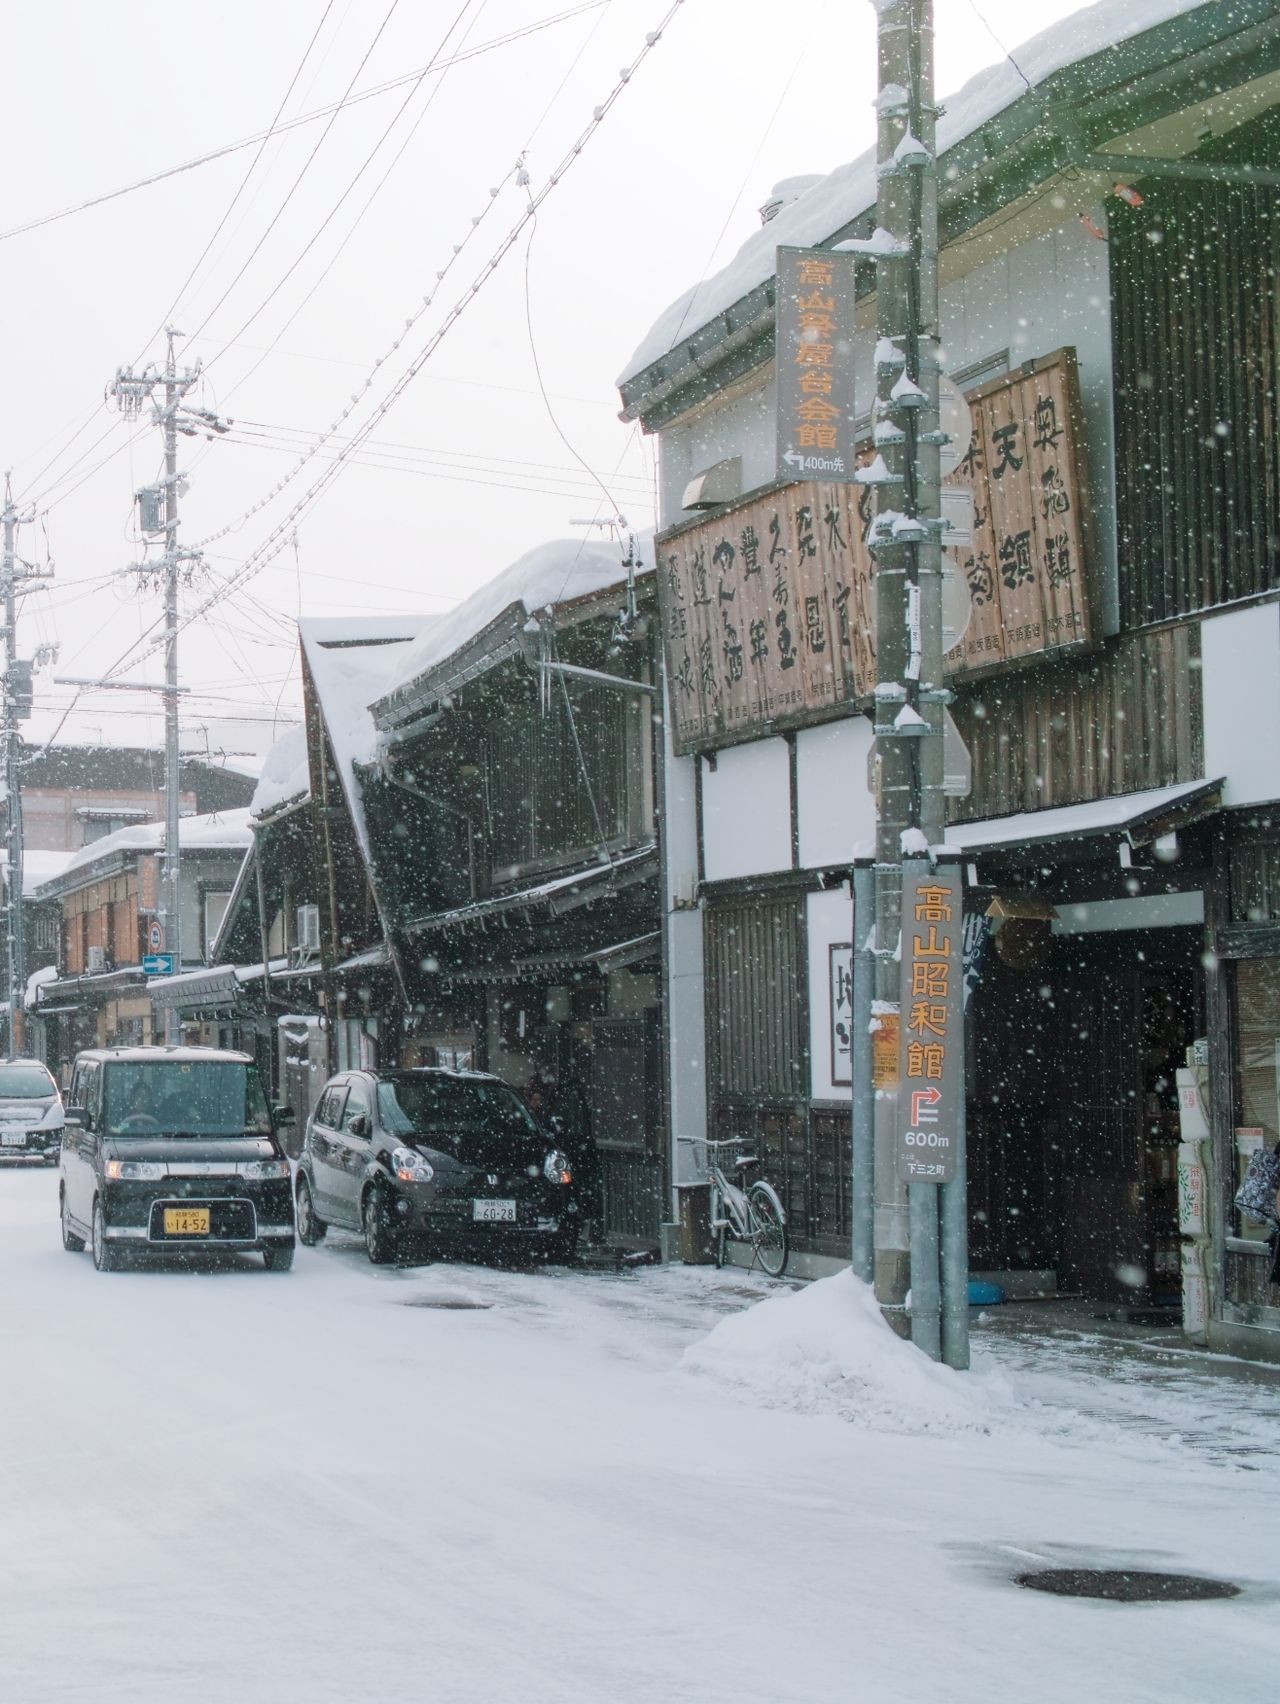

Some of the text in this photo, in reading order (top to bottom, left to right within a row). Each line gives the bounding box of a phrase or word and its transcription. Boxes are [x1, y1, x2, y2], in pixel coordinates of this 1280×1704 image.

[794, 259, 840, 449] 高山祭屋台会館
[804, 456, 845, 473] 400m先
[907, 884, 953, 1080] 高山昭和館
[905, 1131, 950, 1148] 600m
[907, 1163, 945, 1175] 下三之町
[483, 1209, 513, 1220] 60-28
[176, 1219, 207, 1231] 14-52
